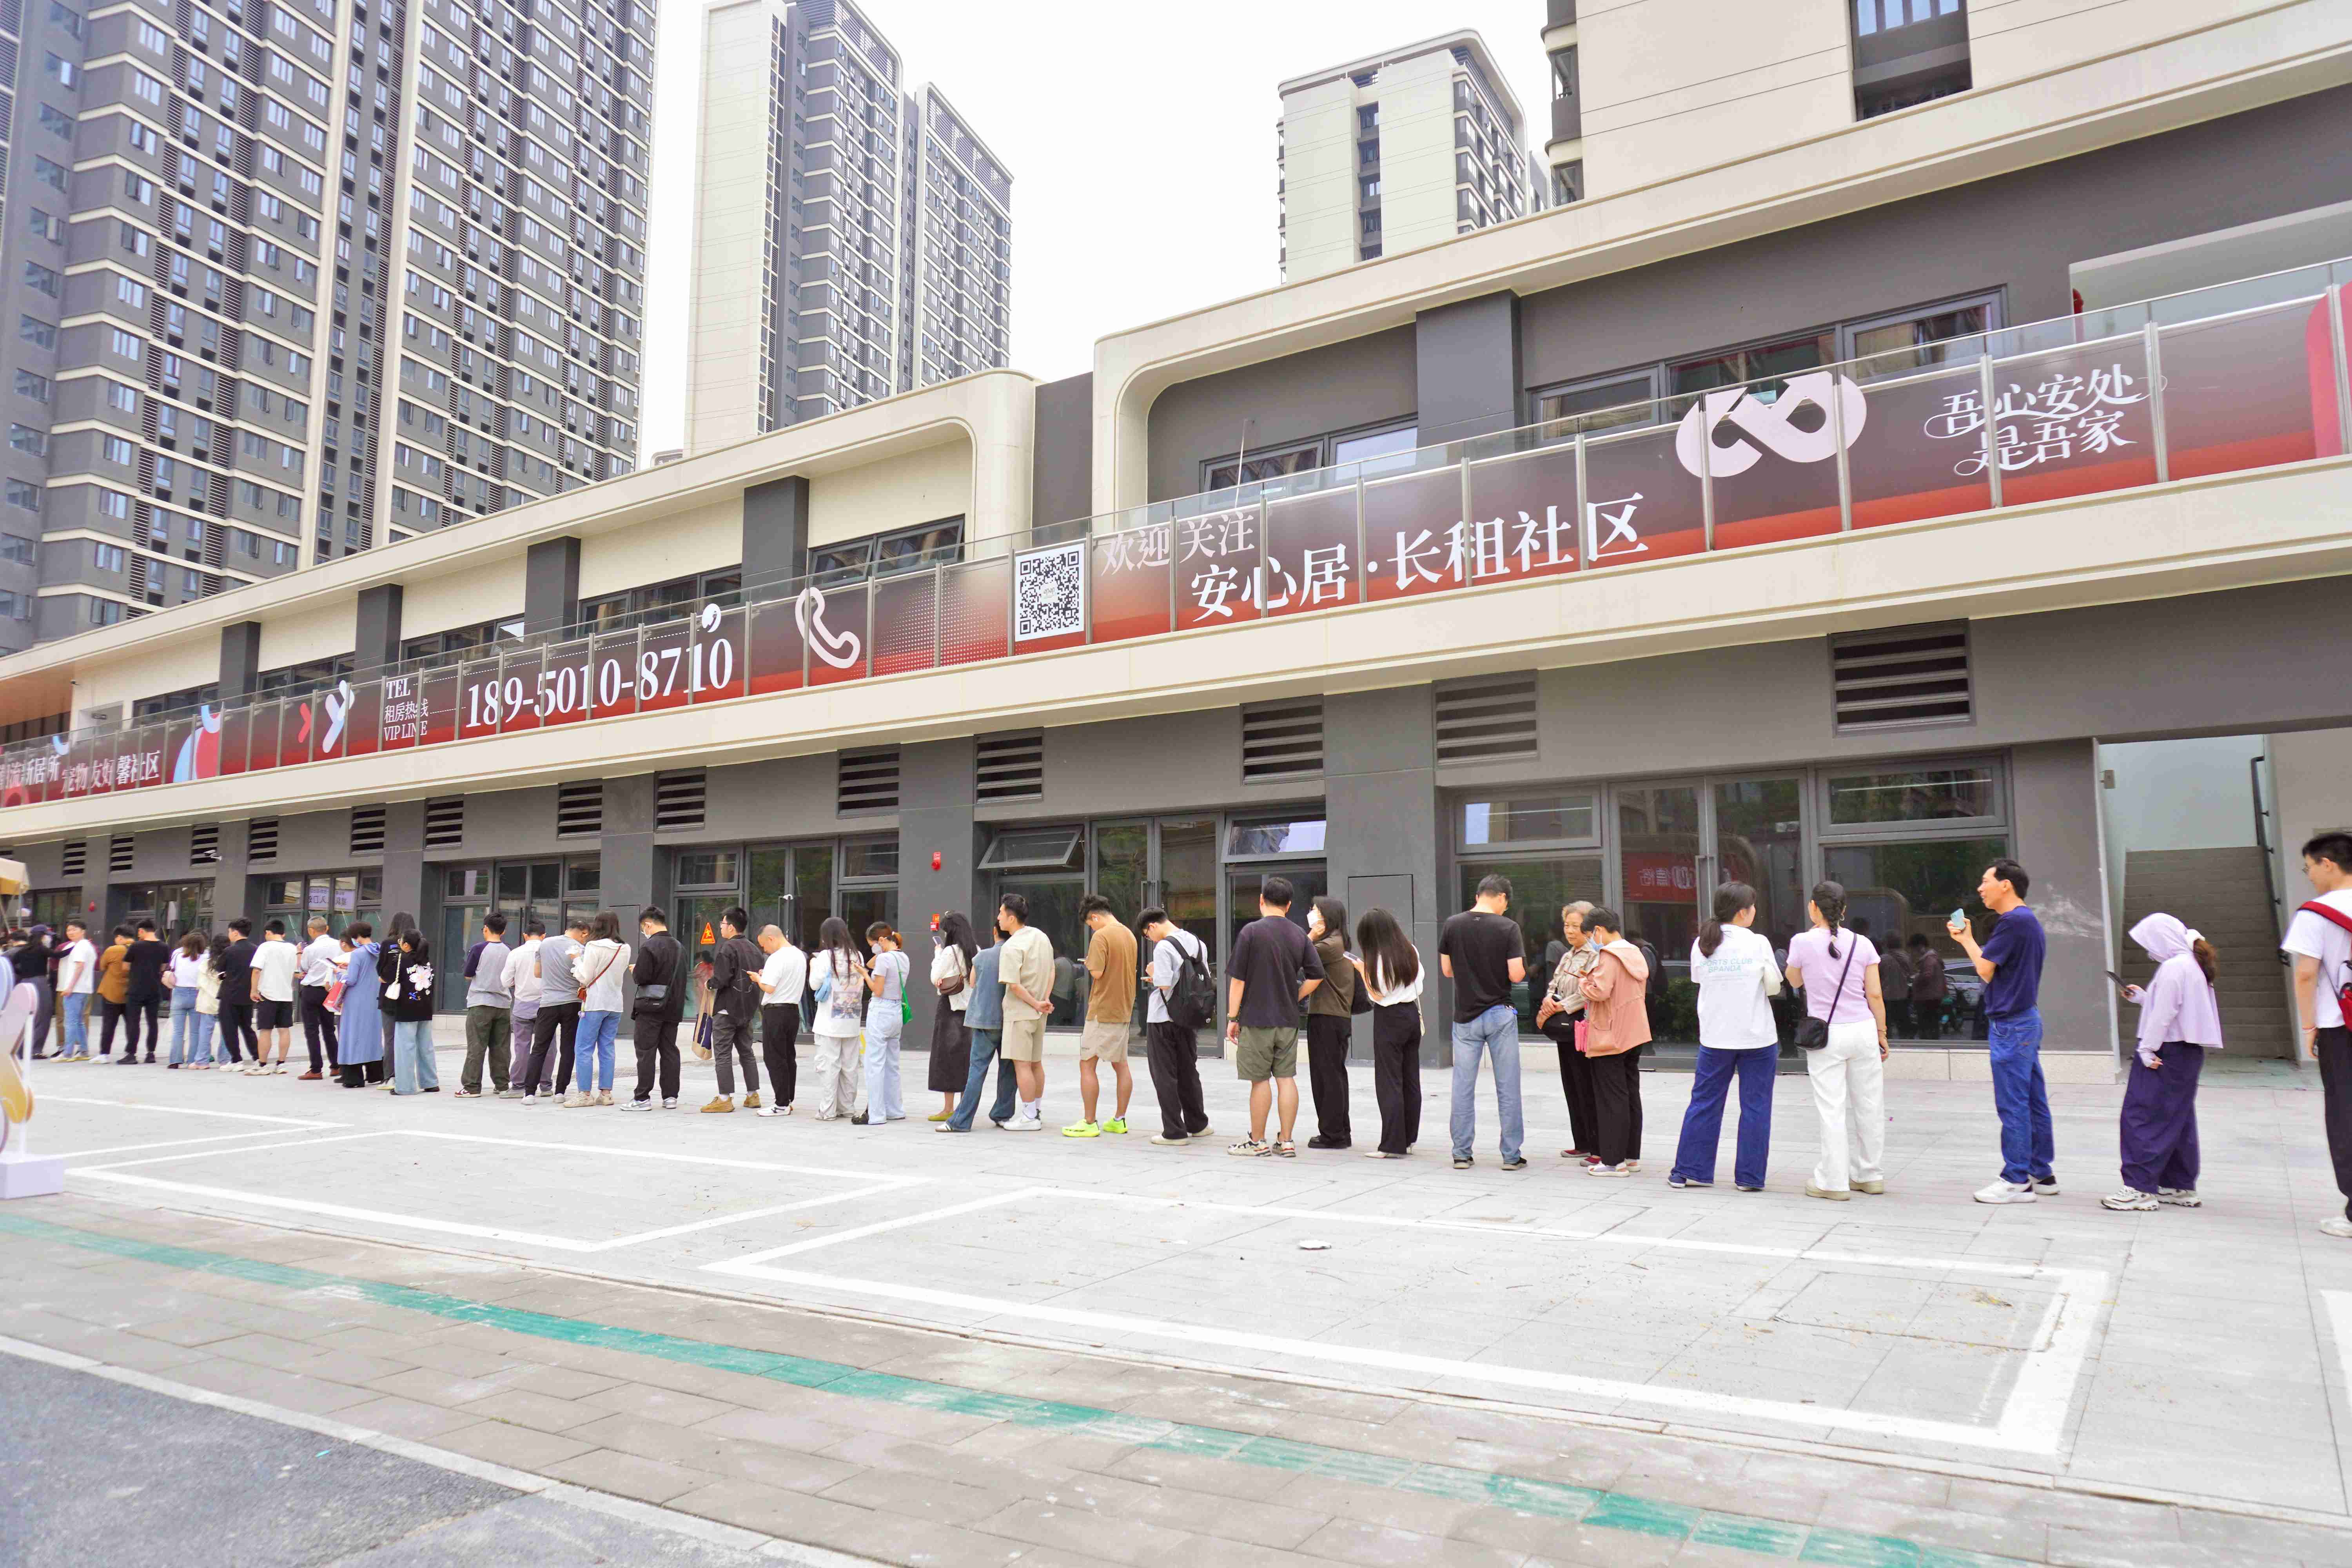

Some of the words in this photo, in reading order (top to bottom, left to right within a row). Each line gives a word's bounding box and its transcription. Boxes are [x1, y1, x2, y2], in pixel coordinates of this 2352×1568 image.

[1924, 364, 2167, 438] 吾心安处
[1954, 410, 2137, 475] 是吾家
[1101, 511, 1255, 576] 欢迎关注
[384, 698, 428, 723] 租房热线
[386, 678, 410, 699] TEL
[466, 639, 733, 727] 189-5010-8710
[384, 725, 401, 741] VIP
